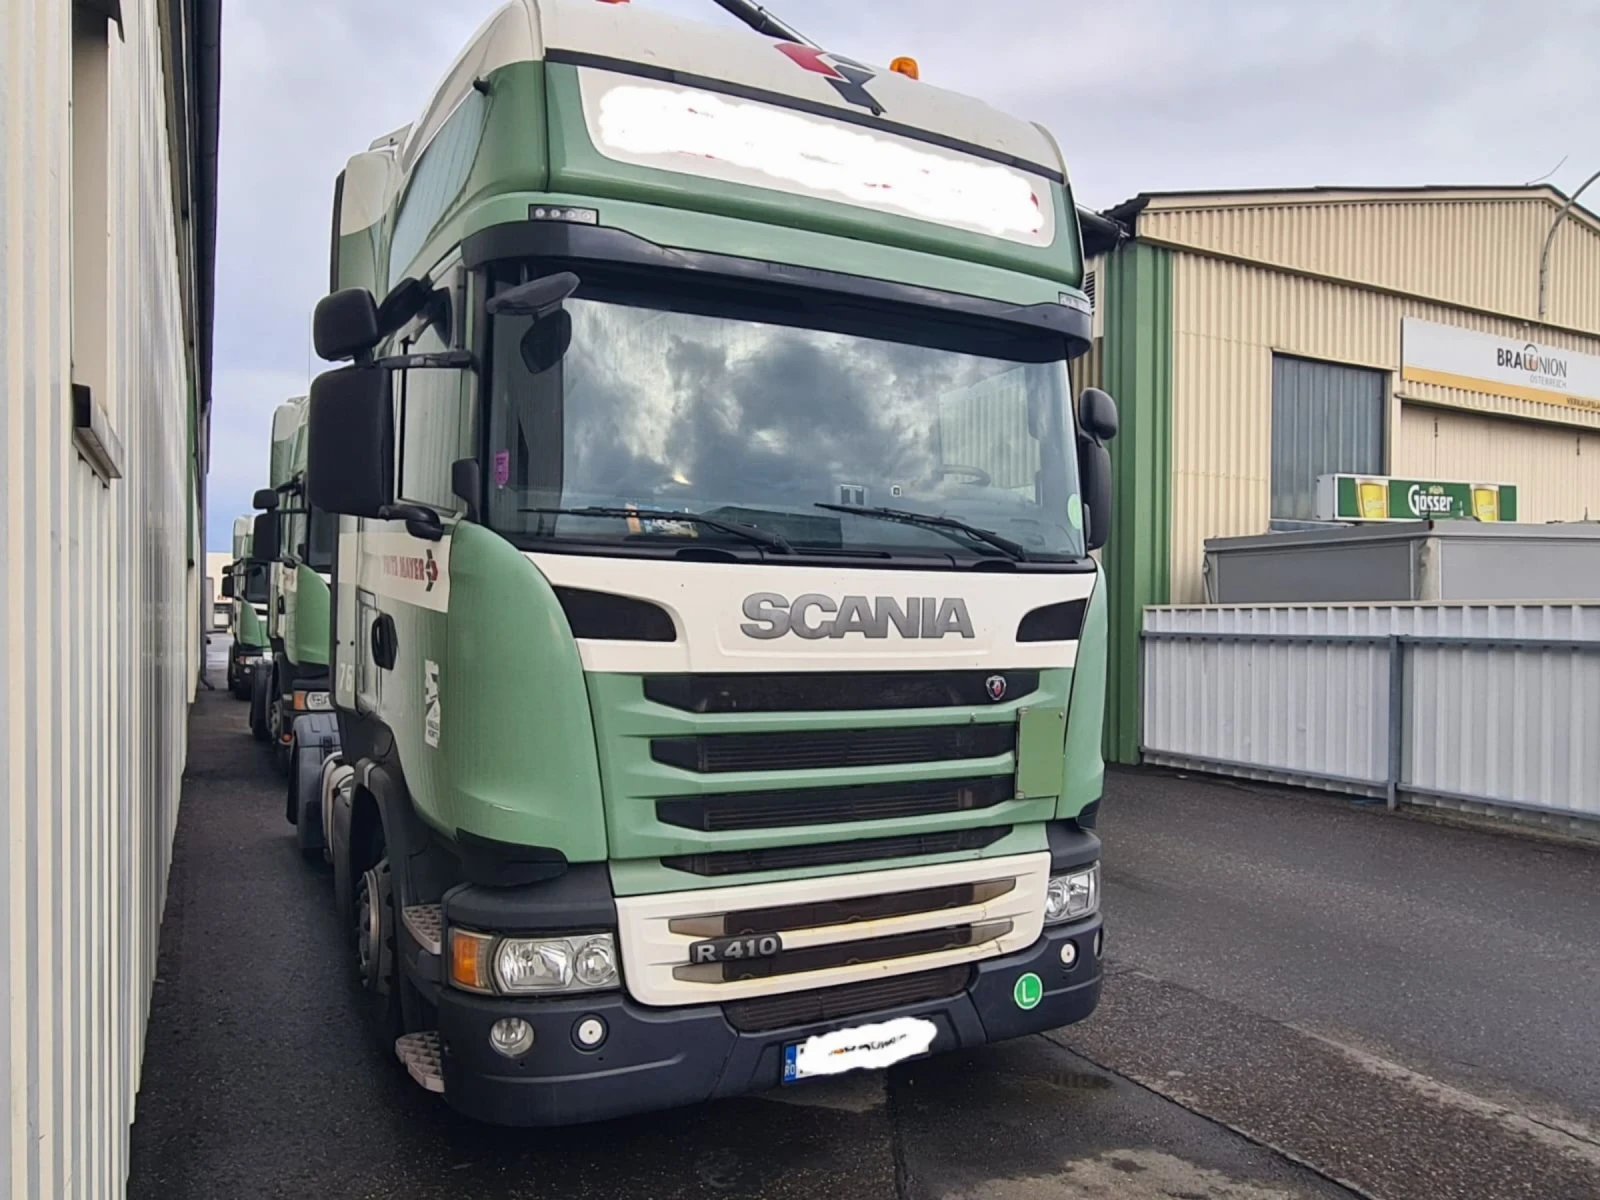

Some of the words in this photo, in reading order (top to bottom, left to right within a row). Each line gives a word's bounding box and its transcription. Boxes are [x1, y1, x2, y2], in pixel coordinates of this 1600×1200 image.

[1408, 484, 1453, 516] Gösser
[400, 556, 425, 581] MAYER
[740, 592, 975, 639] SCANIA
[697, 944, 716, 963] R
[724, 937, 777, 959] 410
[1022, 980, 1036, 1003] L
